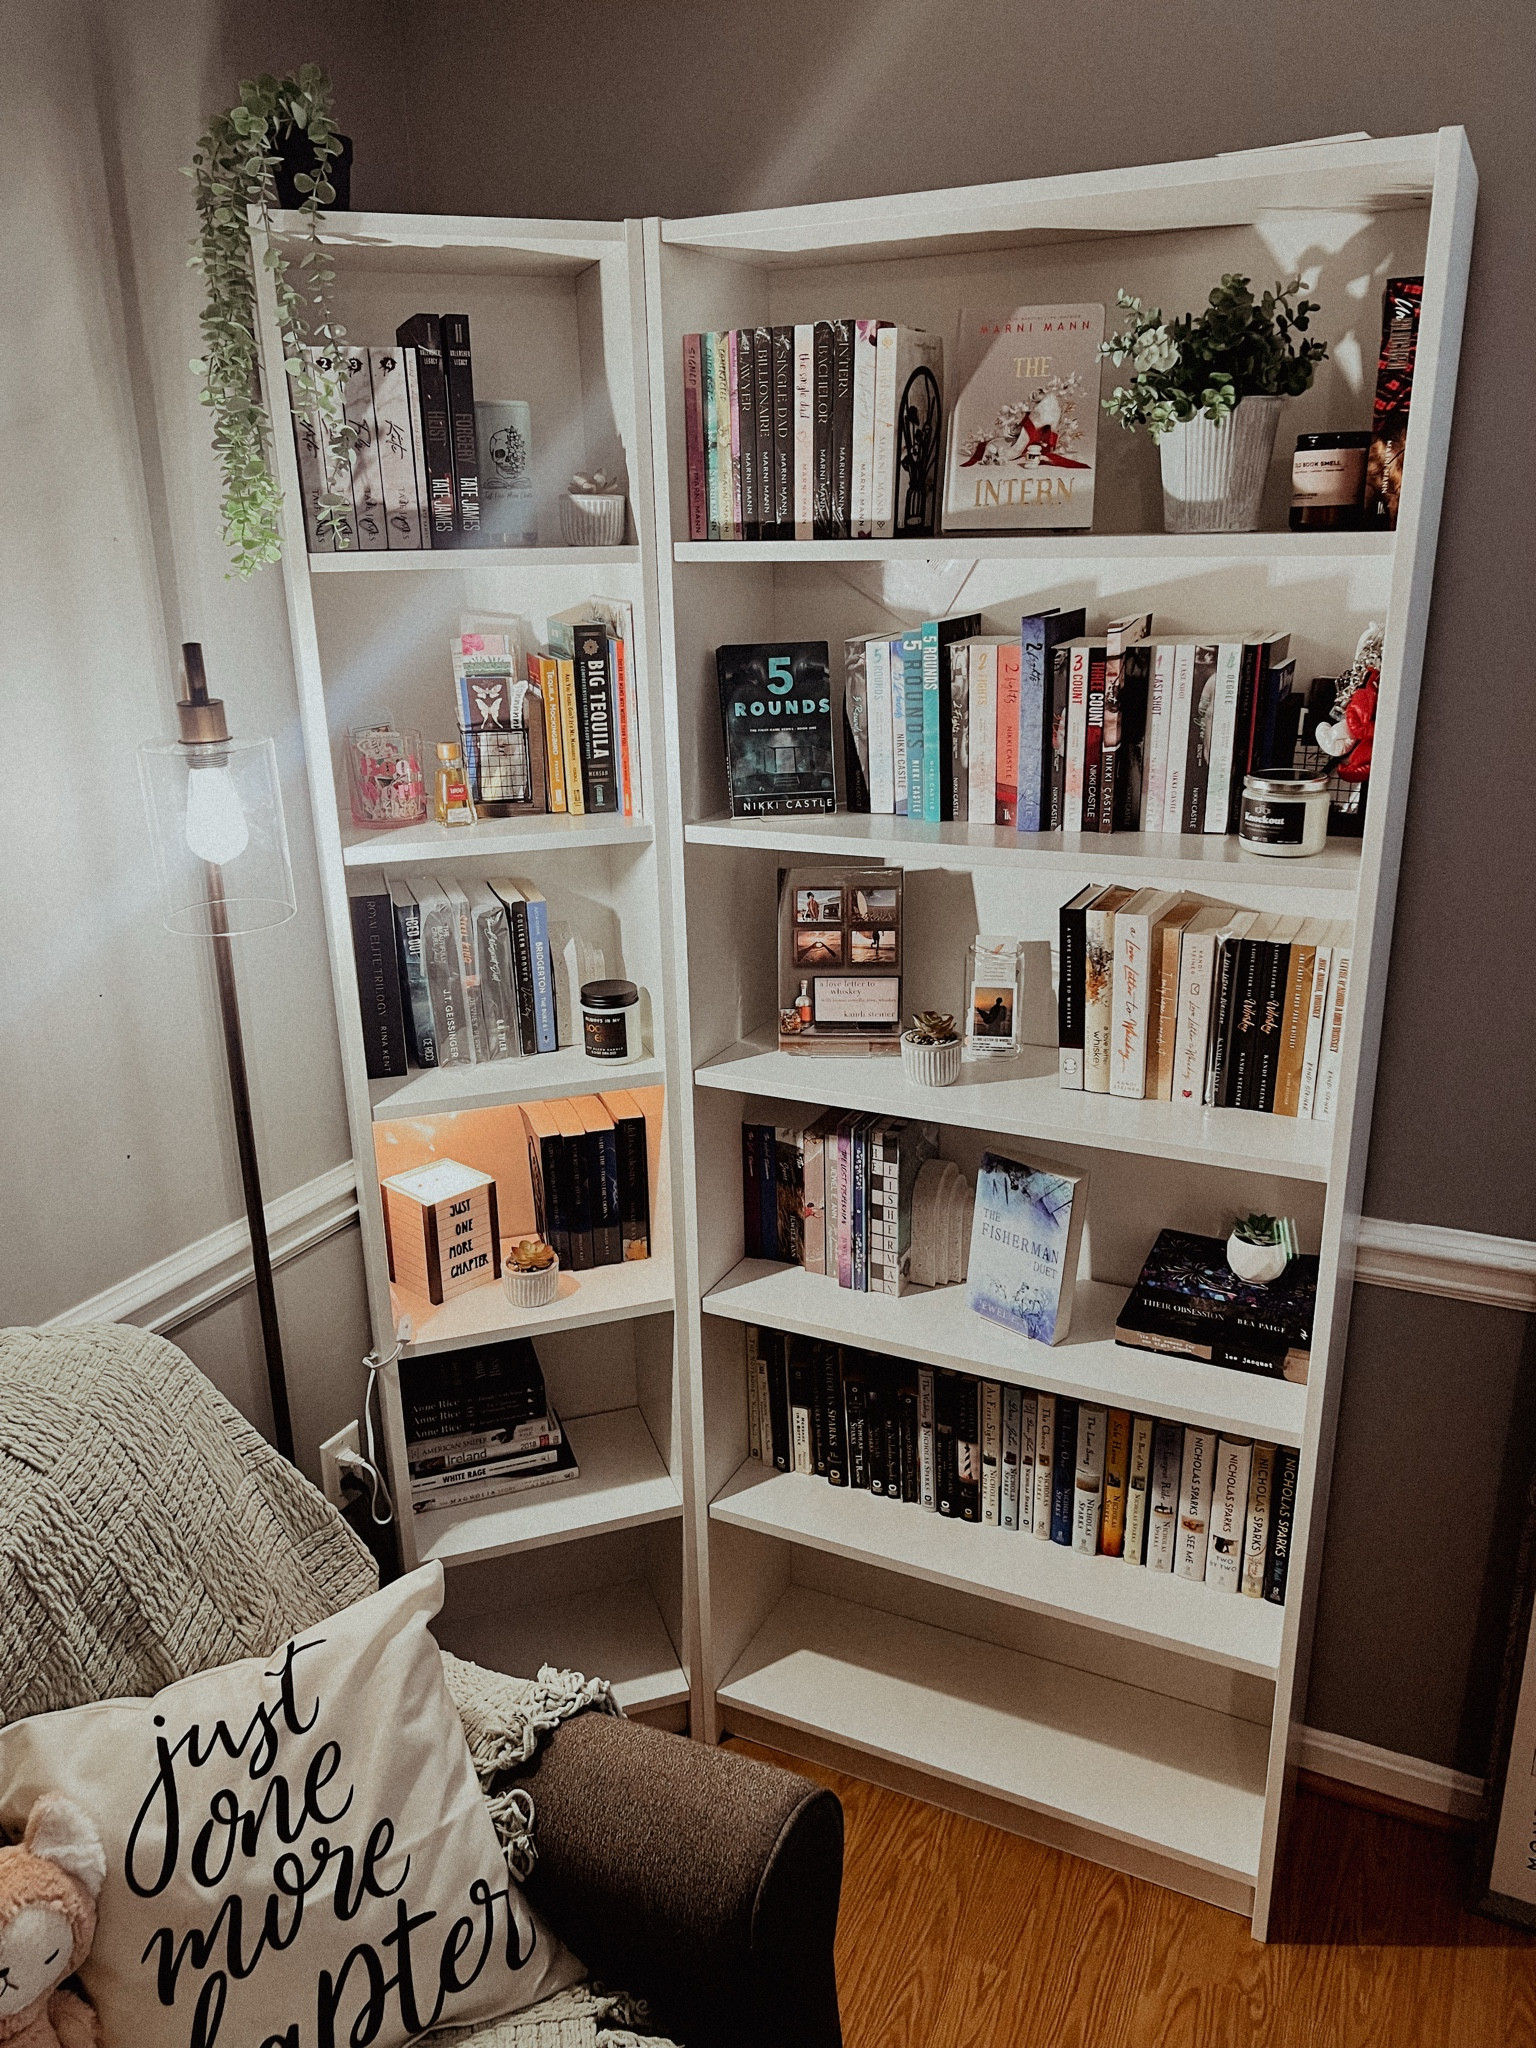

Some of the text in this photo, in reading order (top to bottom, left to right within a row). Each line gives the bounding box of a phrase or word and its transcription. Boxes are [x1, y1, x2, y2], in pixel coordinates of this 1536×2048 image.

[980, 322, 1036, 335] MARNI
[1044, 320, 1091, 333] MANN
[384, 359, 393, 370] 4
[741, 350, 753, 412] LAWYER
[837, 342, 849, 399] INTERN
[1013, 355, 1051, 379] THE
[757, 349, 770, 437] BILLIONAIRE
[775, 350, 789, 438] SINGLE DAD
[817, 345, 829, 424] BACHELOR
[427, 411, 446, 444] HEIST
[799, 401, 810, 419] dad
[455, 413, 476, 465] FORGERY
[838, 447, 846, 478] MARNI
[780, 453, 788, 516] MARNI MANN
[974, 477, 1075, 508] INTERN
[432, 477, 453, 533] TATE JAMES
[459, 476, 481, 532] TATE JAMES
[924, 635, 938, 691] 5 ROUNDS
[1026, 642, 1043, 651] 2
[766, 656, 794, 695] 5
[874, 665, 884, 701] ROUNDS
[1005, 663, 1019, 673] 2
[1072, 654, 1083, 705] 3 COUNT
[734, 697, 831, 717] ROUNDS
[903, 640, 924, 749] 5 ROUNDS
[977, 673, 987, 706] FIGHTS
[1088, 661, 1105, 728] THREE COUNT
[1151, 674, 1163, 716] LAST SHOT
[1224, 674, 1234, 704] DEGREE
[547, 669, 559, 756] TEQUILA MOCKINGBIRD
[587, 659, 610, 760] BIG TEQUILA
[952, 708, 963, 733] Fights
[897, 733, 906, 790] NIKKI CASTLE
[911, 759, 922, 813] NIKKI CASTLE
[1086, 764, 1098, 818] NIKKI CASTLE
[1102, 754, 1113, 825] NIKKI CASTLE
[743, 798, 833, 811] NIKKI CASTLE
[952, 793, 960, 816] CASTLE
[1189, 804, 1198, 829] CASTLE
[1244, 811, 1285, 825] Knockout
[405, 916, 421, 956] ICED OUT
[366, 900, 387, 1018] ROYAL ELITE TRILOGY
[516, 912, 532, 1019] COLLEEN HOOVER Verity
[535, 941, 547, 994] BRIDGERTON
[826, 980, 843, 988] love
[830, 988, 863, 997] whiskey
[869, 1010, 897, 1018] steiner
[1118, 939, 1141, 1073] Love Letter Whiskey
[1188, 1000, 1200, 1017] Love
[1236, 998, 1257, 1033] Whiskey
[1260, 999, 1280, 1035] Whiskey
[445, 1005, 459, 1058] GEISSINGER
[1187, 1018, 1200, 1042] Letter
[380, 1025, 391, 1073] RINA KENT
[1091, 1030, 1102, 1069] whiskey
[1235, 1077, 1244, 1107] STEINER
[1258, 1054, 1270, 1110] KANDI STEINER
[830, 1166, 838, 1194] JEWEL
[450, 1199, 472, 1219] JUST
[455, 1218, 474, 1236] ONE
[982, 1206, 1001, 1221] THE
[885, 1165, 896, 1294] FISHERMAN
[981, 1221, 1060, 1266] FISHERMAN
[449, 1239, 473, 1258] MORE
[451, 1253, 490, 1279] CHAPTER
[1033, 1260, 1058, 1280] DUET
[1142, 1298, 1287, 1335] THEIR OBSESSION BEA PAIGE
[1224, 1353, 1274, 1369] lee jacquot
[825, 1354, 838, 1447] NICHOLAS SPARKS
[421, 1437, 487, 1456] AMERICAN SNIPER
[441, 1424, 462, 1434] Rice
[850, 1422, 858, 1445] SPARKS
[984, 1423, 996, 1446] Sight
[1040, 1408, 1051, 1451] The Choice
[1083, 1415, 1097, 1467] The Last Song
[447, 1440, 537, 1466] Ireland 2018
[923, 1429, 932, 1491] NICHOLAS SPARKS
[442, 1467, 487, 1484] WHITE RAGE
[989, 1469, 998, 1507] NICHOLAS
[1009, 1467, 1018, 1503] NICHOLAS
[1043, 1471, 1052, 1508] NICHOLAS
[1160, 1481, 1172, 1501] Ride
[1189, 1437, 1204, 1516] NICHOLAS SPARKS
[1222, 1453, 1239, 1533] NICHOLAS SPARKS
[1253, 1457, 1269, 1514] NICHOLAS
[450, 1490, 496, 1504] MAGNOLIA
[1055, 1489, 1063, 1518] SPARKS
[1062, 1487, 1072, 1524] NICHOLAS
[1077, 1499, 1087, 1530] SPARKS
[1275, 1457, 1297, 1558] NICHOLAS SPARKS
[1085, 1498, 1096, 1537] NICHOLAS
[1251, 1516, 1265, 1551] SPARKS
[1161, 1520, 1171, 1554] NICHOLAS
[1185, 1534, 1196, 1563] SEE ME
[1215, 1556, 1234, 1565] TWO
[125, 1638, 328, 1899] just
[191, 1740, 355, 1888] one
[141, 1816, 412, 2006] more
